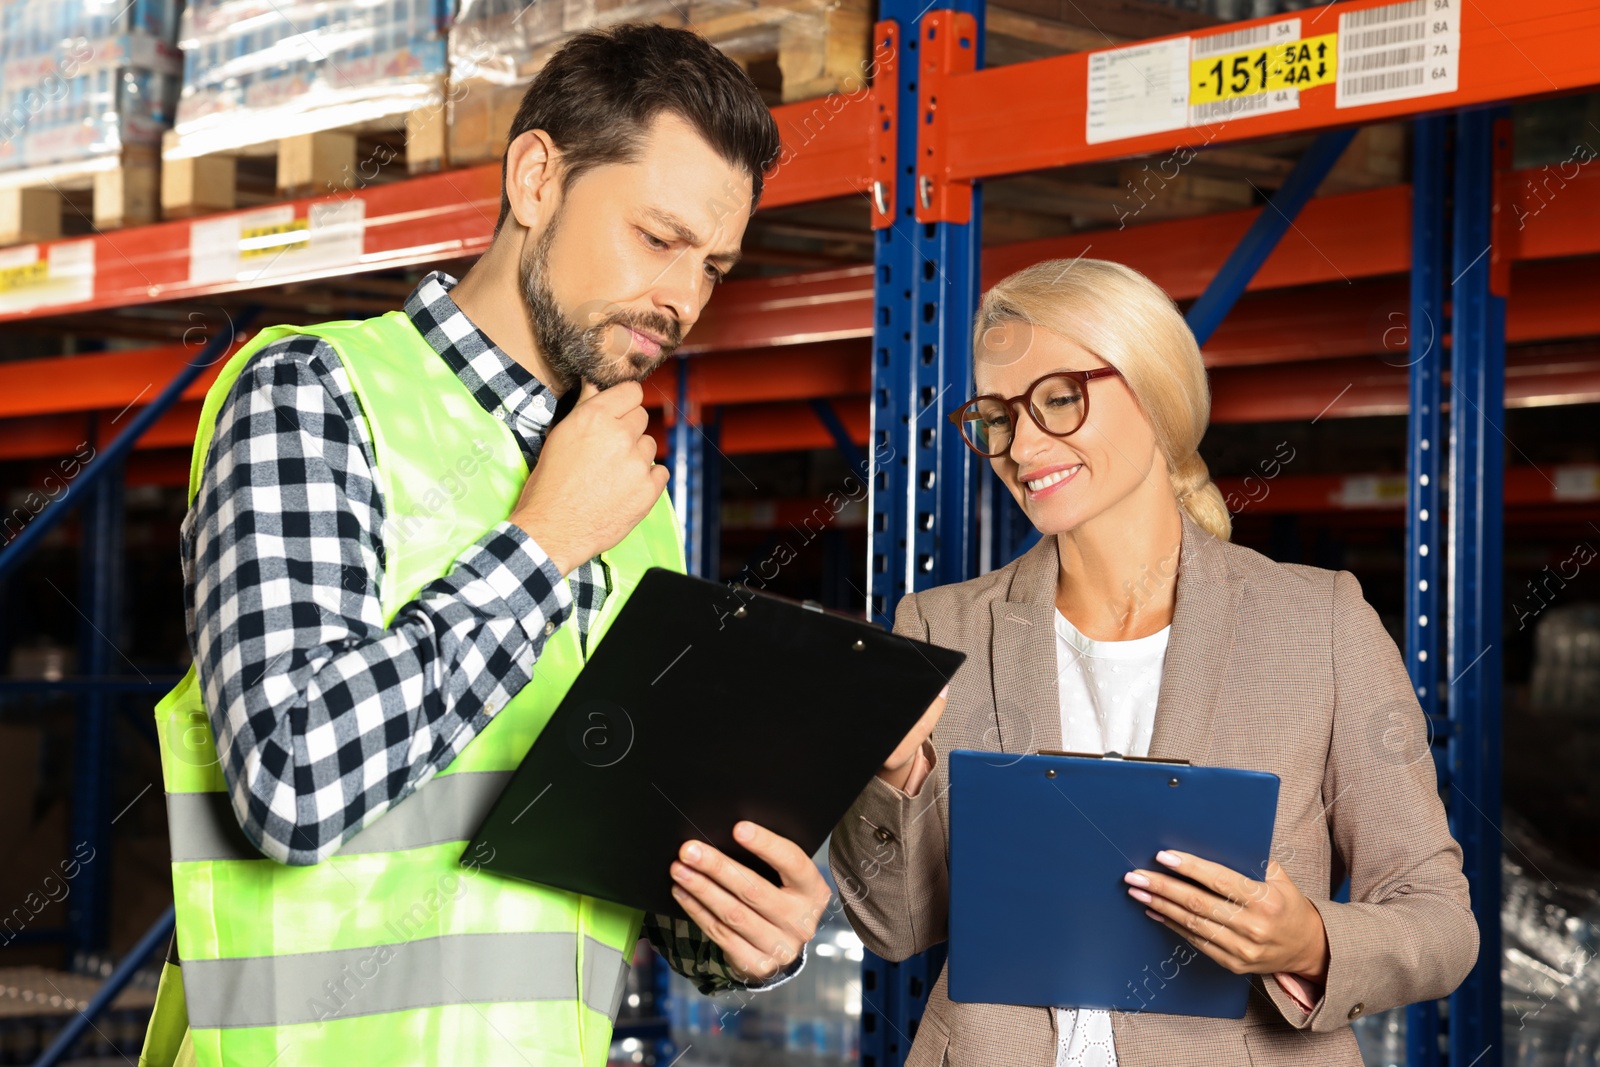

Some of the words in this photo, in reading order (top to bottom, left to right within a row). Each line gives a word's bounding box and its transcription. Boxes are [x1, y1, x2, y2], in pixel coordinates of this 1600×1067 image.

[1433, 21, 1448, 34] 8A
[1433, 44, 1448, 56] 7A
[1431, 67, 1447, 80] 6A
